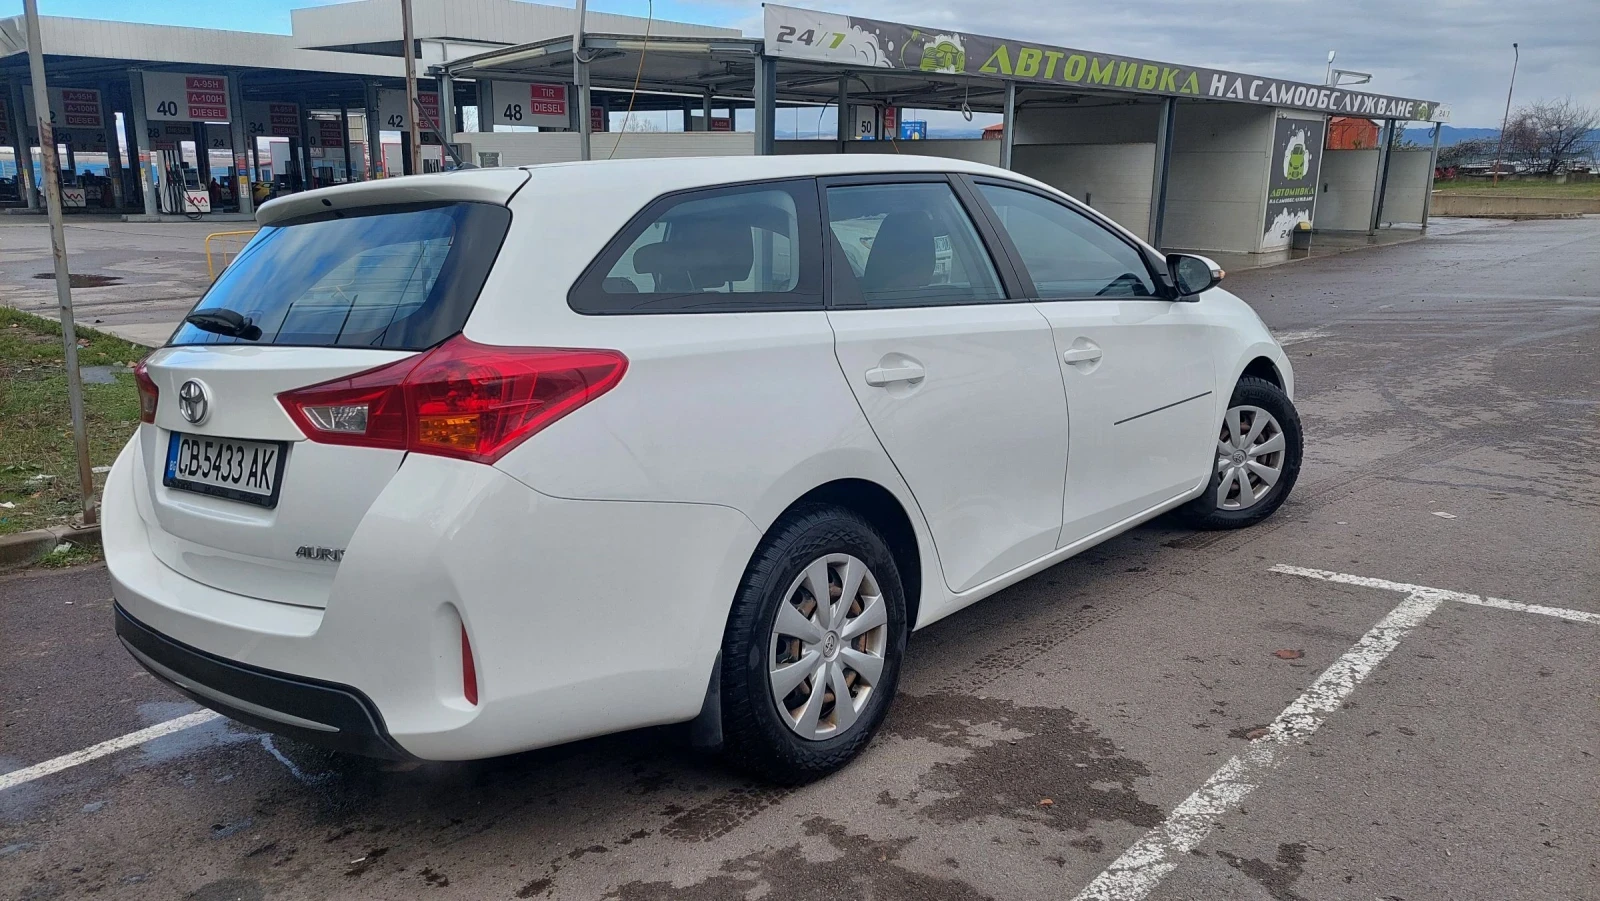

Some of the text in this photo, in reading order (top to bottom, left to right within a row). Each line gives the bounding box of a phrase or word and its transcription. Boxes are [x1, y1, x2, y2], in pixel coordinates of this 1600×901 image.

[776, 25, 847, 49] 24/7
[193, 79, 219, 88] A-95H
[978, 44, 1200, 95] АВТОМИВКА
[1249, 79, 1415, 117] САМООБСЛУЖВАНЕ
[68, 92, 93, 100] A-95H
[191, 94, 223, 103] A-100H
[541, 88, 555, 97] TIR
[156, 100, 178, 116] 40
[192, 108, 225, 117] DIESEL
[503, 103, 523, 121] 48
[534, 103, 563, 113] DIESEL
[387, 114, 404, 128] 42
[861, 120, 872, 133] 50
[249, 122, 265, 134] 34
[213, 138, 225, 148] 24
[1270, 187, 1314, 198] АВТОМИВКА
[245, 447, 275, 490] AK
[295, 545, 346, 562] AURI
